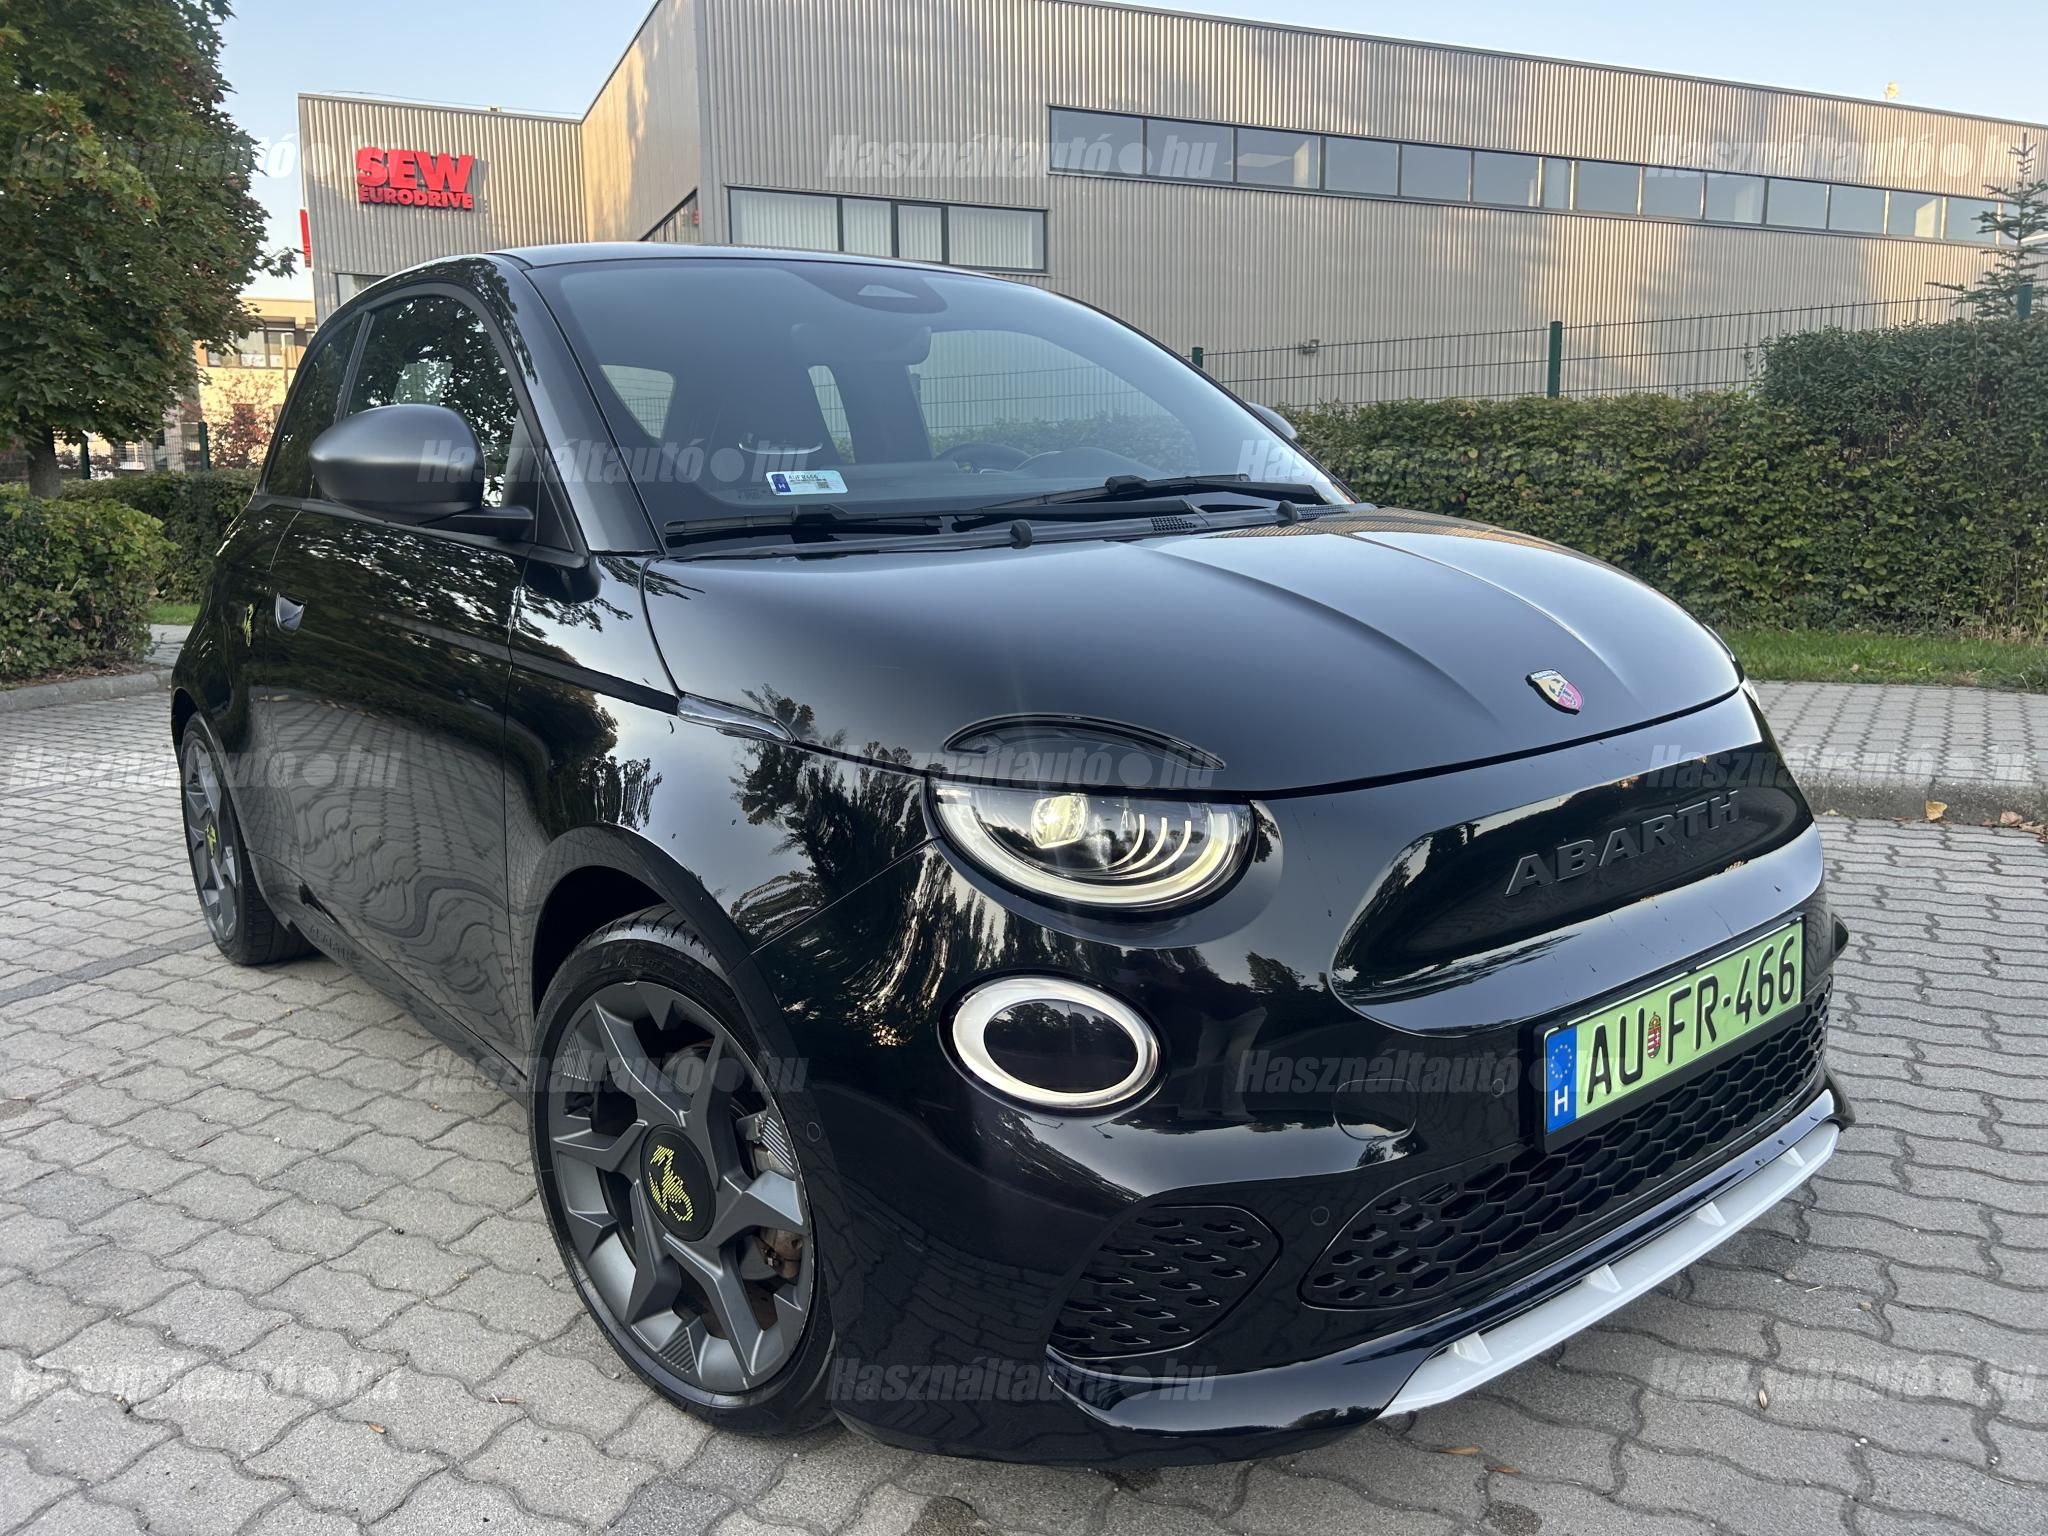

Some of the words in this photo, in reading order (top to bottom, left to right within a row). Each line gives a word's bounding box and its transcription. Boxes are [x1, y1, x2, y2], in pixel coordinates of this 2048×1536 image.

[356, 147, 475, 193] SEW
[359, 186, 473, 209] EURODRIVE
[1504, 789, 1740, 897] ABARTH
[1554, 1085, 1568, 1116] H
